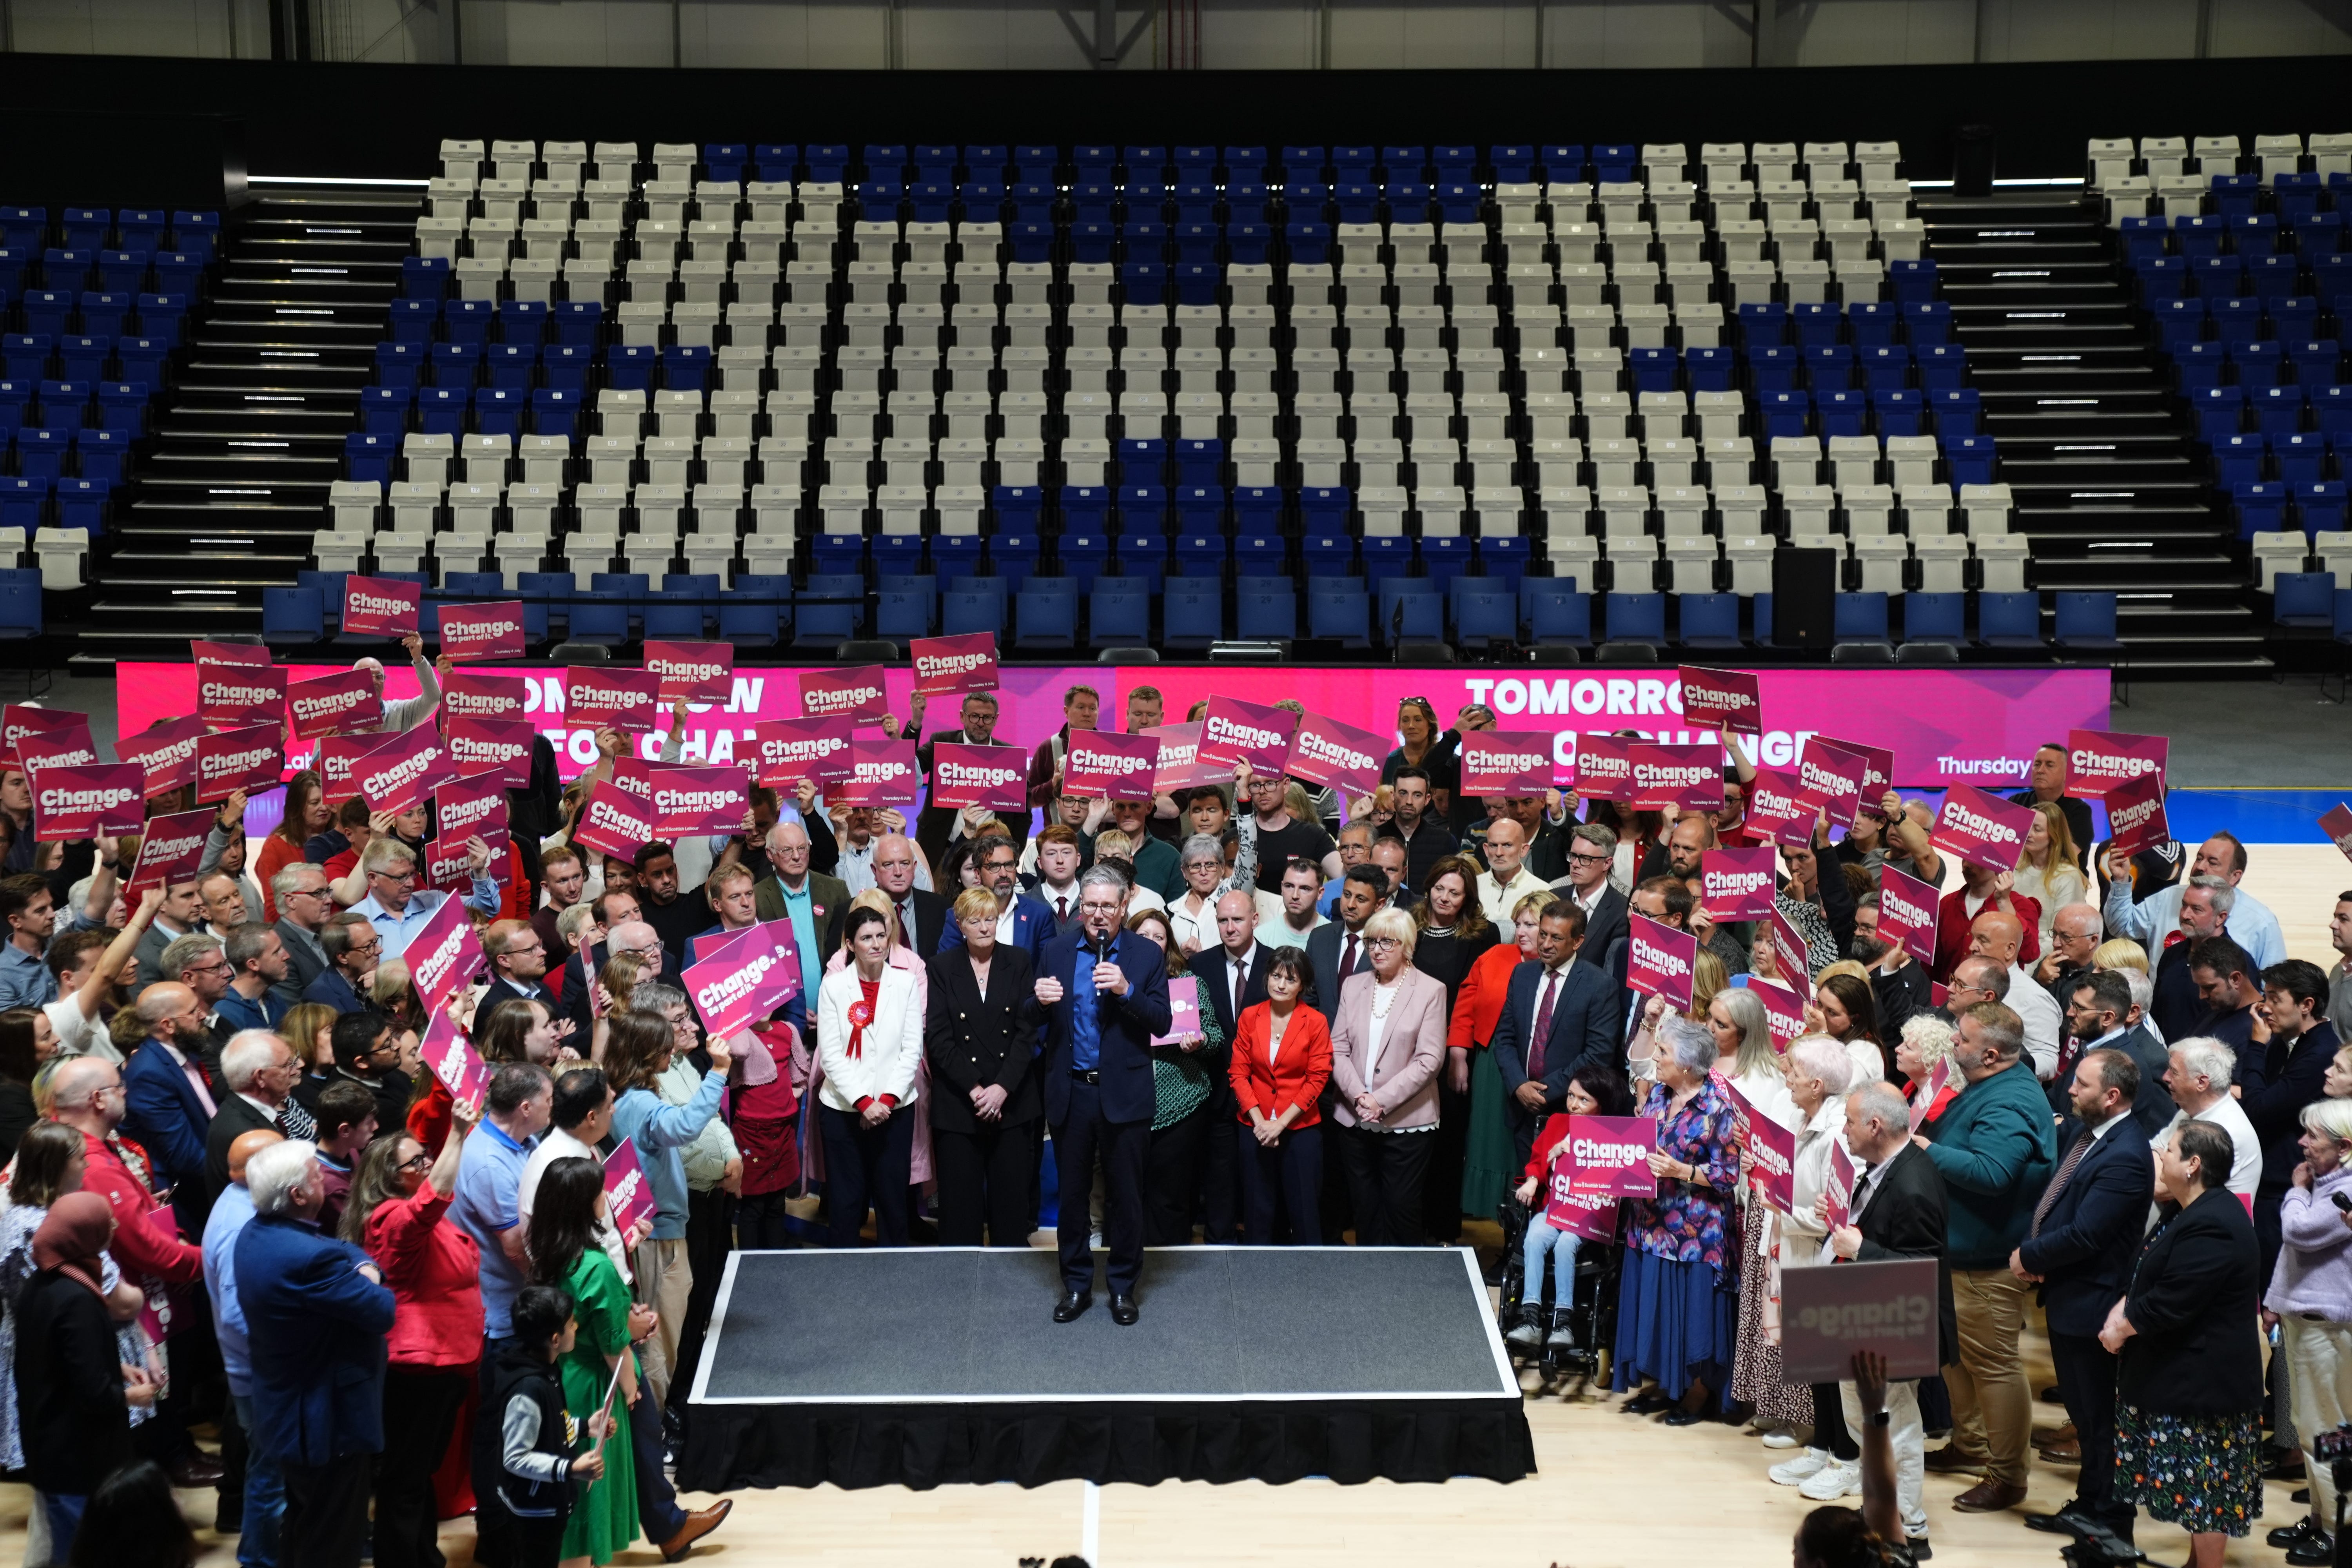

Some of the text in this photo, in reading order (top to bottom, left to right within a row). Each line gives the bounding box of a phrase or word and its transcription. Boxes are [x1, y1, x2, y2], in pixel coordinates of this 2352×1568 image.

[349, 593, 415, 615] Change.
[444, 621, 519, 637] Change.
[648, 659, 728, 681] Change.
[916, 653, 992, 670] Change.
[931, 668, 948, 678] part
[202, 683, 282, 704] Change.
[293, 690, 372, 713] Change.
[446, 692, 521, 713] Change.
[570, 685, 653, 708] Change.
[805, 687, 882, 705] Change.
[1465, 679, 1684, 715] TOMORR
[1684, 685, 1756, 710] Change.
[1208, 717, 1286, 748] Change.
[1208, 732, 1218, 740] Be
[1219, 736, 1238, 745] part
[1247, 740, 1256, 749] it.
[451, 737, 528, 761] Change.
[543, 729, 601, 765] FO
[762, 738, 848, 757] Change.
[1299, 731, 1378, 770] Change.
[201, 748, 277, 771] Change.
[363, 748, 443, 793] Change.
[778, 755, 798, 765] part
[1071, 750, 1152, 774] Change.
[1466, 750, 1550, 771] Change.
[1481, 766, 1499, 775] part
[1937, 756, 2032, 780] Thursday
[2072, 750, 2161, 777] Change.
[938, 762, 1022, 786] Change.
[1634, 764, 1719, 784] Change.
[1650, 780, 1669, 789] part
[1801, 762, 1857, 796] Change.
[41, 788, 139, 808] Change.
[441, 795, 503, 822] Change.
[655, 789, 744, 809] Change.
[671, 806, 691, 815] part
[2111, 799, 2160, 827] Change.
[1943, 817, 1954, 826] Be
[1953, 822, 1972, 834] part
[1945, 802, 2020, 844] Change.
[144, 835, 204, 857] Change.
[1705, 871, 1772, 892] Change.
[1717, 888, 1731, 898] part
[1882, 889, 1933, 928] Change.
[416, 923, 469, 986] Change.
[1632, 938, 1690, 976] Change.
[698, 955, 777, 1008] Change.
[1577, 1158, 1623, 1169] Be part of it.
[1751, 1133, 1791, 1176] Change.
